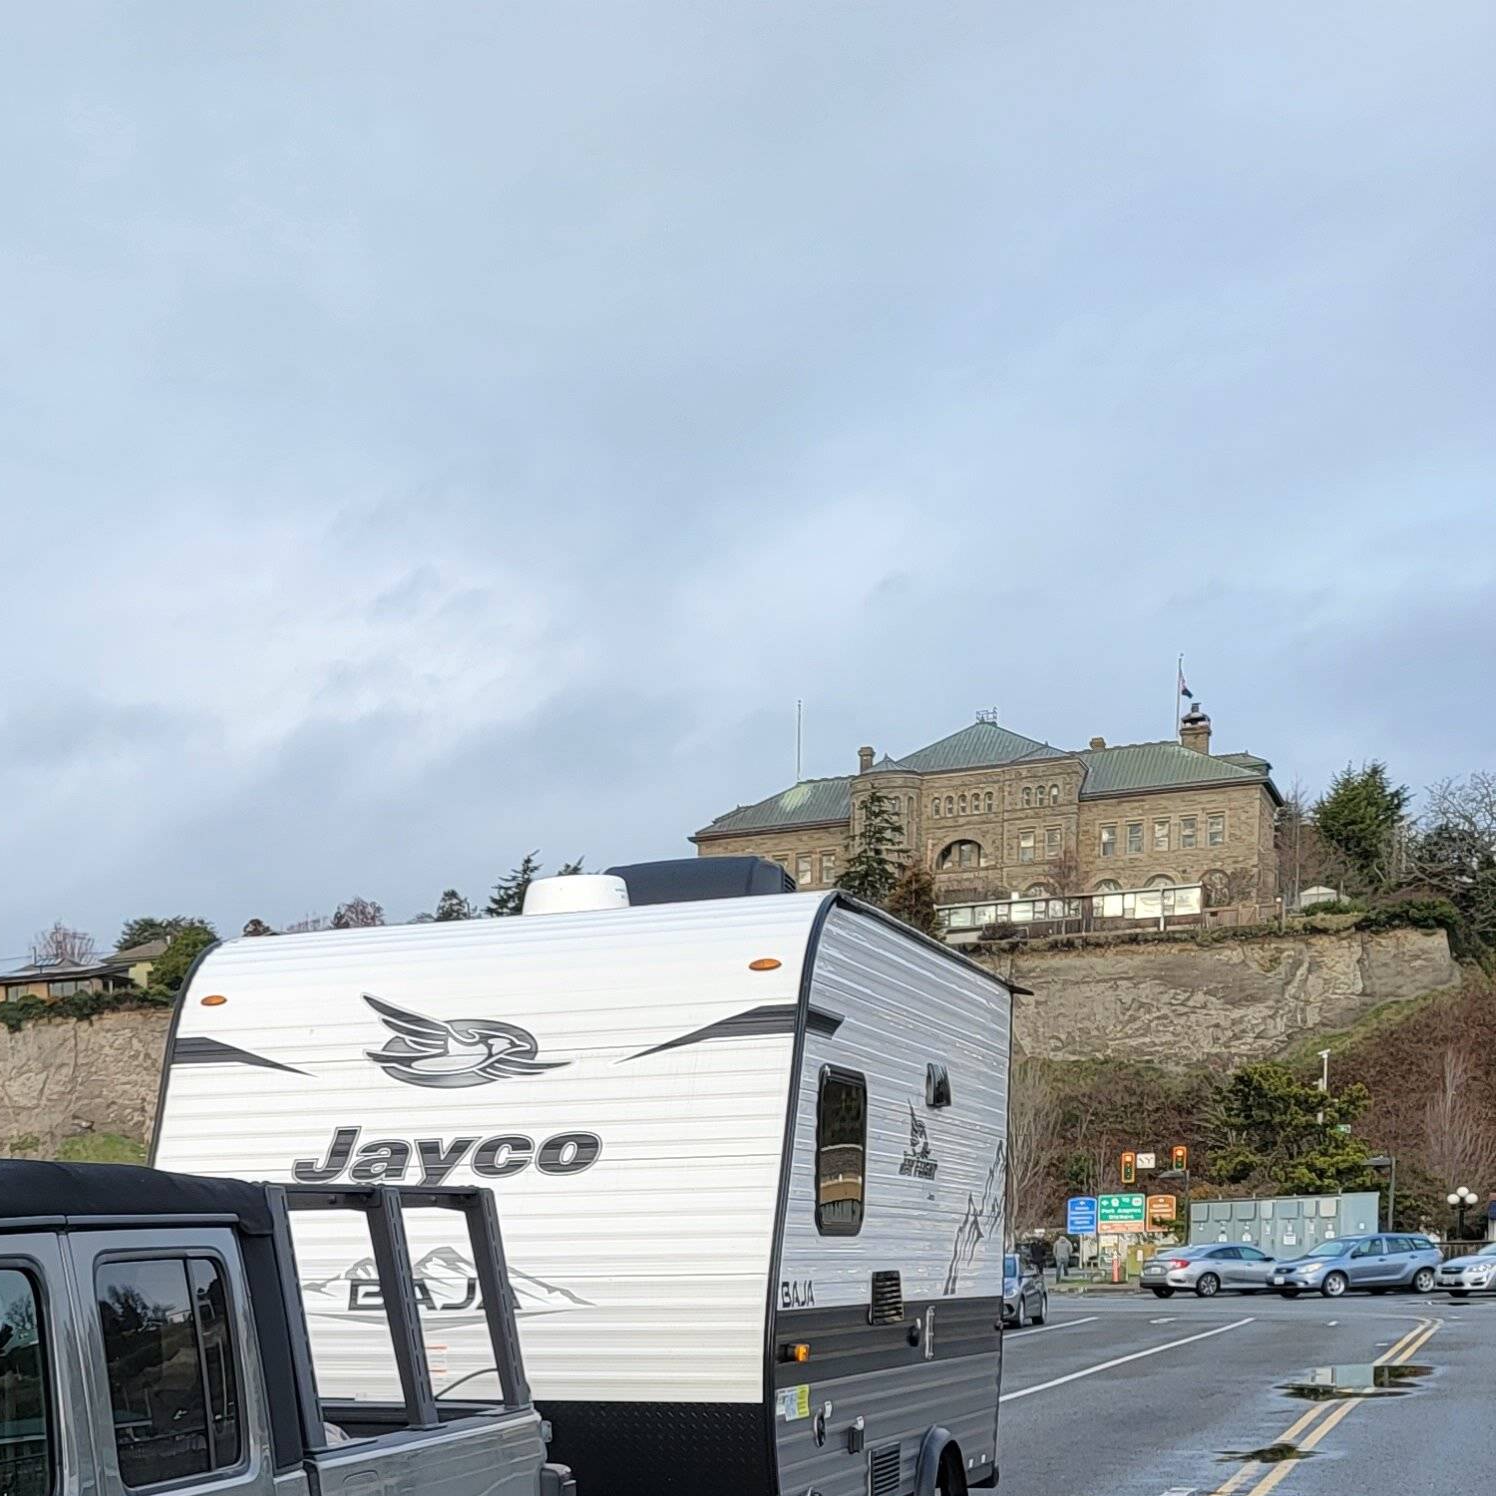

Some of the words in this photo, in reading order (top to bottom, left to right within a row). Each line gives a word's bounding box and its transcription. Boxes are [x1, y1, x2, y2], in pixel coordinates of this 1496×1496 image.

[292, 1126, 602, 1186] Jayco
[348, 1277, 522, 1310] BAJ
[781, 1280, 815, 1308] BAJA
